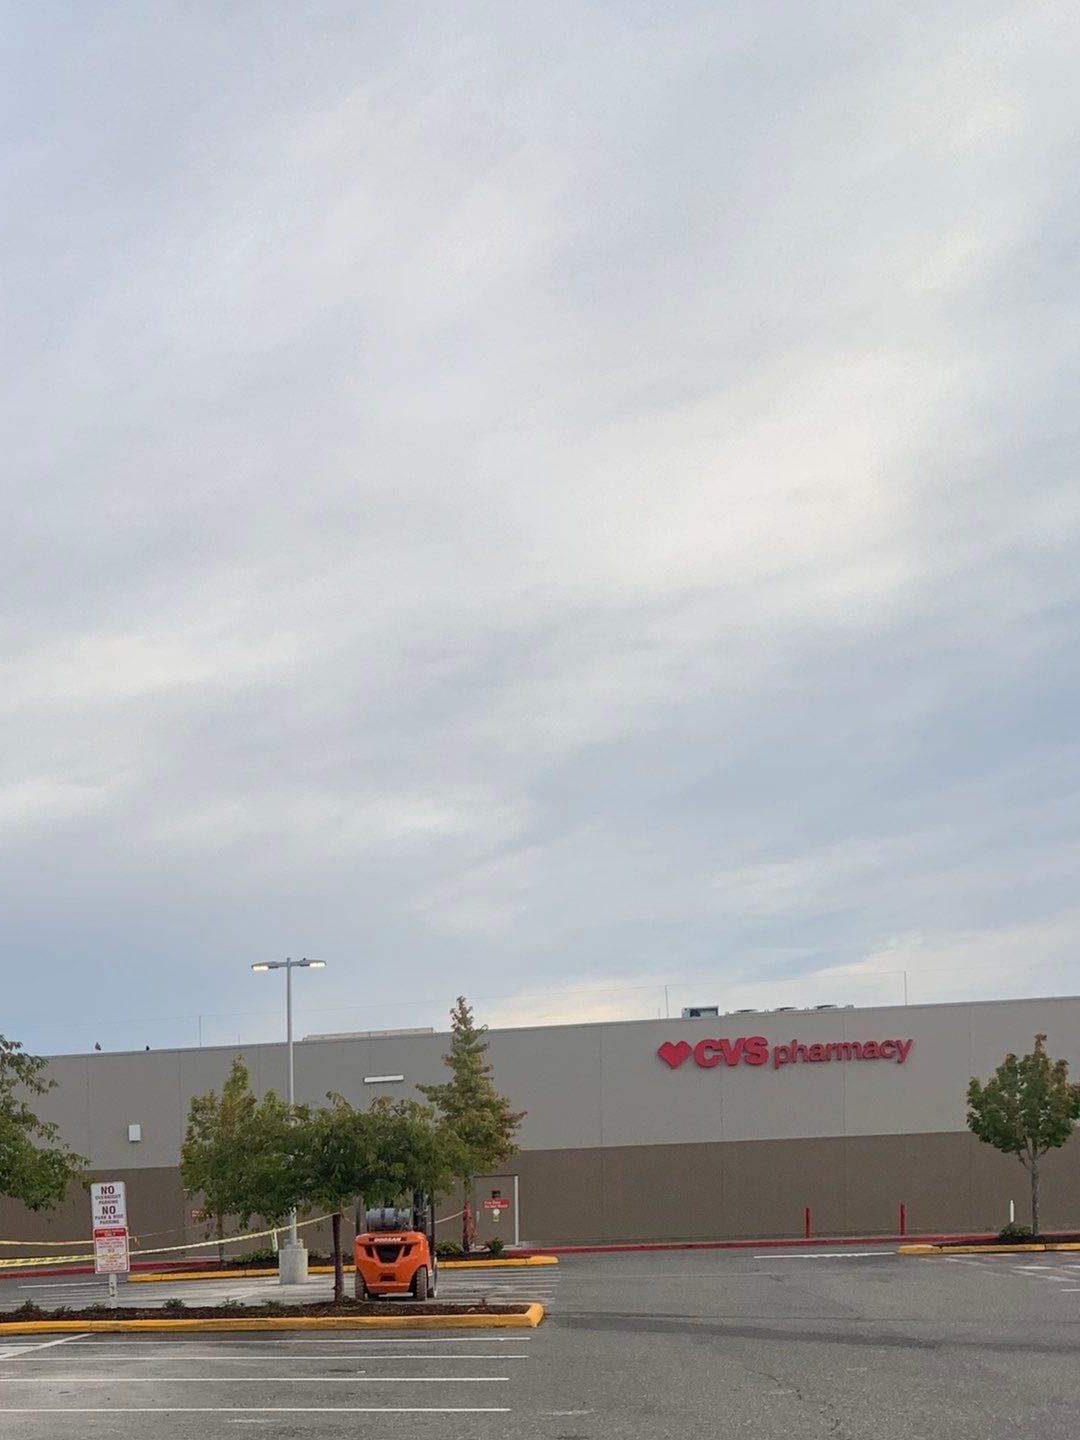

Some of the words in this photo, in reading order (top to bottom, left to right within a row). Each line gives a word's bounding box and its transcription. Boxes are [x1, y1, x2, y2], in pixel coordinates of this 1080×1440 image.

[695, 1036, 769, 1068] CVS
[774, 1039, 913, 1069] pharmacy
[100, 1185, 115, 1195] NO
[102, 1205, 116, 1215] NO
